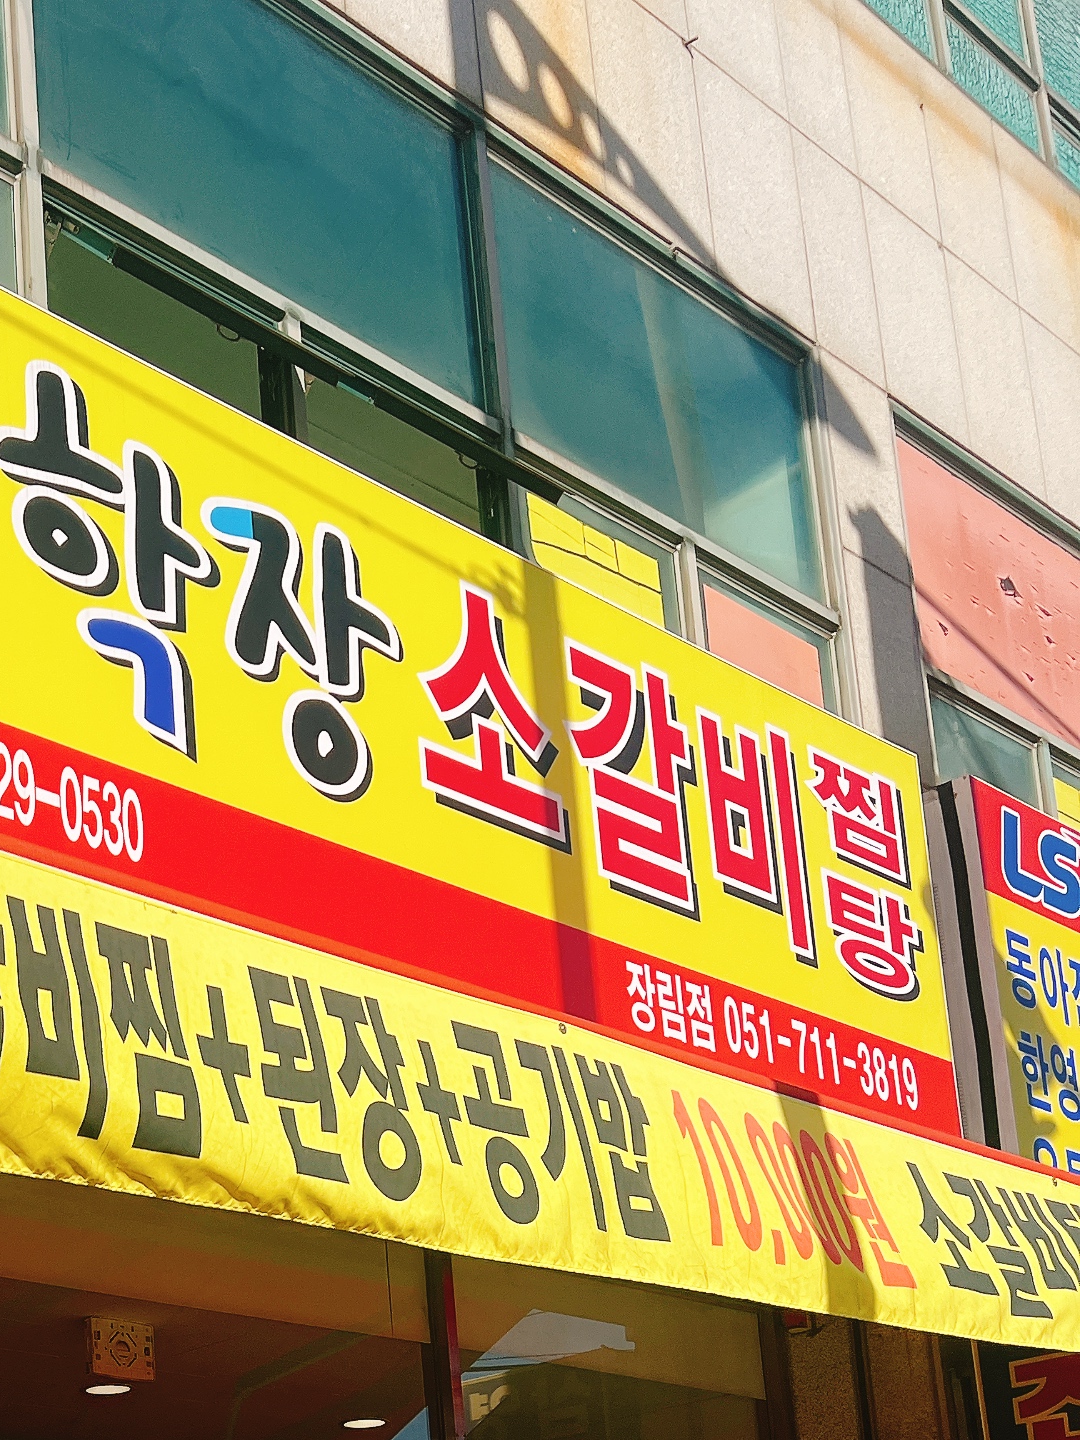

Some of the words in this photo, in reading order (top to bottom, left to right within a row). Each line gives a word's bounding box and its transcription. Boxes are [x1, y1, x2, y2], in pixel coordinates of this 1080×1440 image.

[626, 960, 715, 1054] 장림점
[726, 996, 919, 1111] 051-711-3819
[671, 1089, 917, 1289] 10,000원
